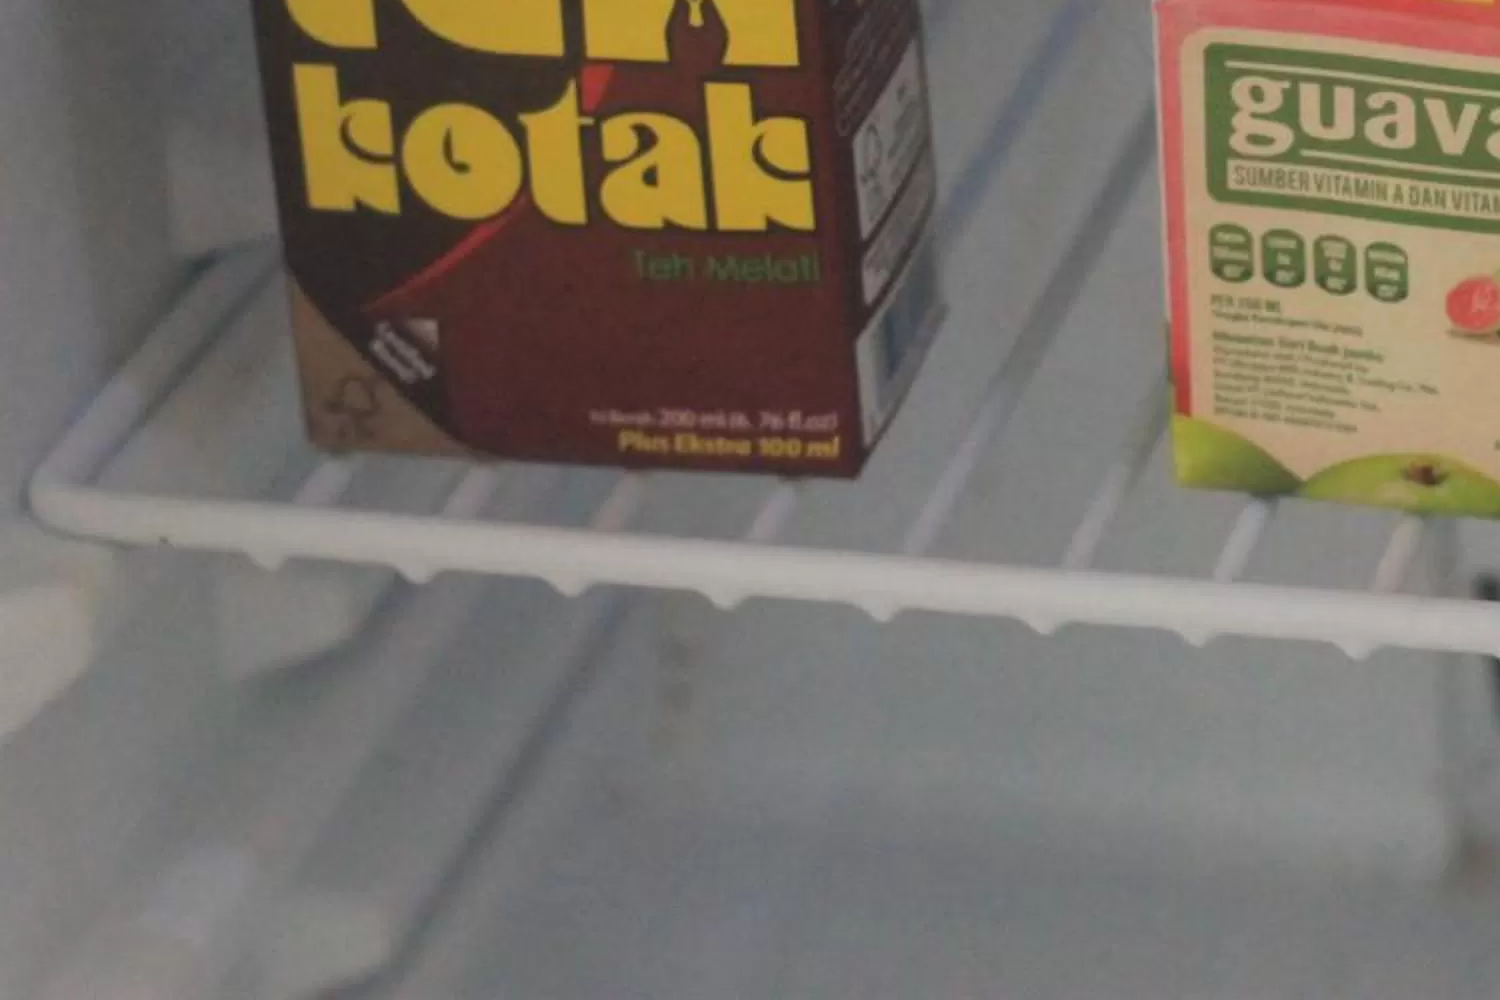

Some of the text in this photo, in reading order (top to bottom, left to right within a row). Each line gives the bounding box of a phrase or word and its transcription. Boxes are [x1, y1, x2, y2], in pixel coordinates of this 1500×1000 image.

[292, 62, 816, 232] kotak
[1234, 164, 1310, 190] SUMBER
[1312, 172, 1390, 202] VITAMIN
[1392, 185, 1408, 205] A
[1408, 187, 1447, 210] DAN
[631, 248, 822, 283] Teh Melati
